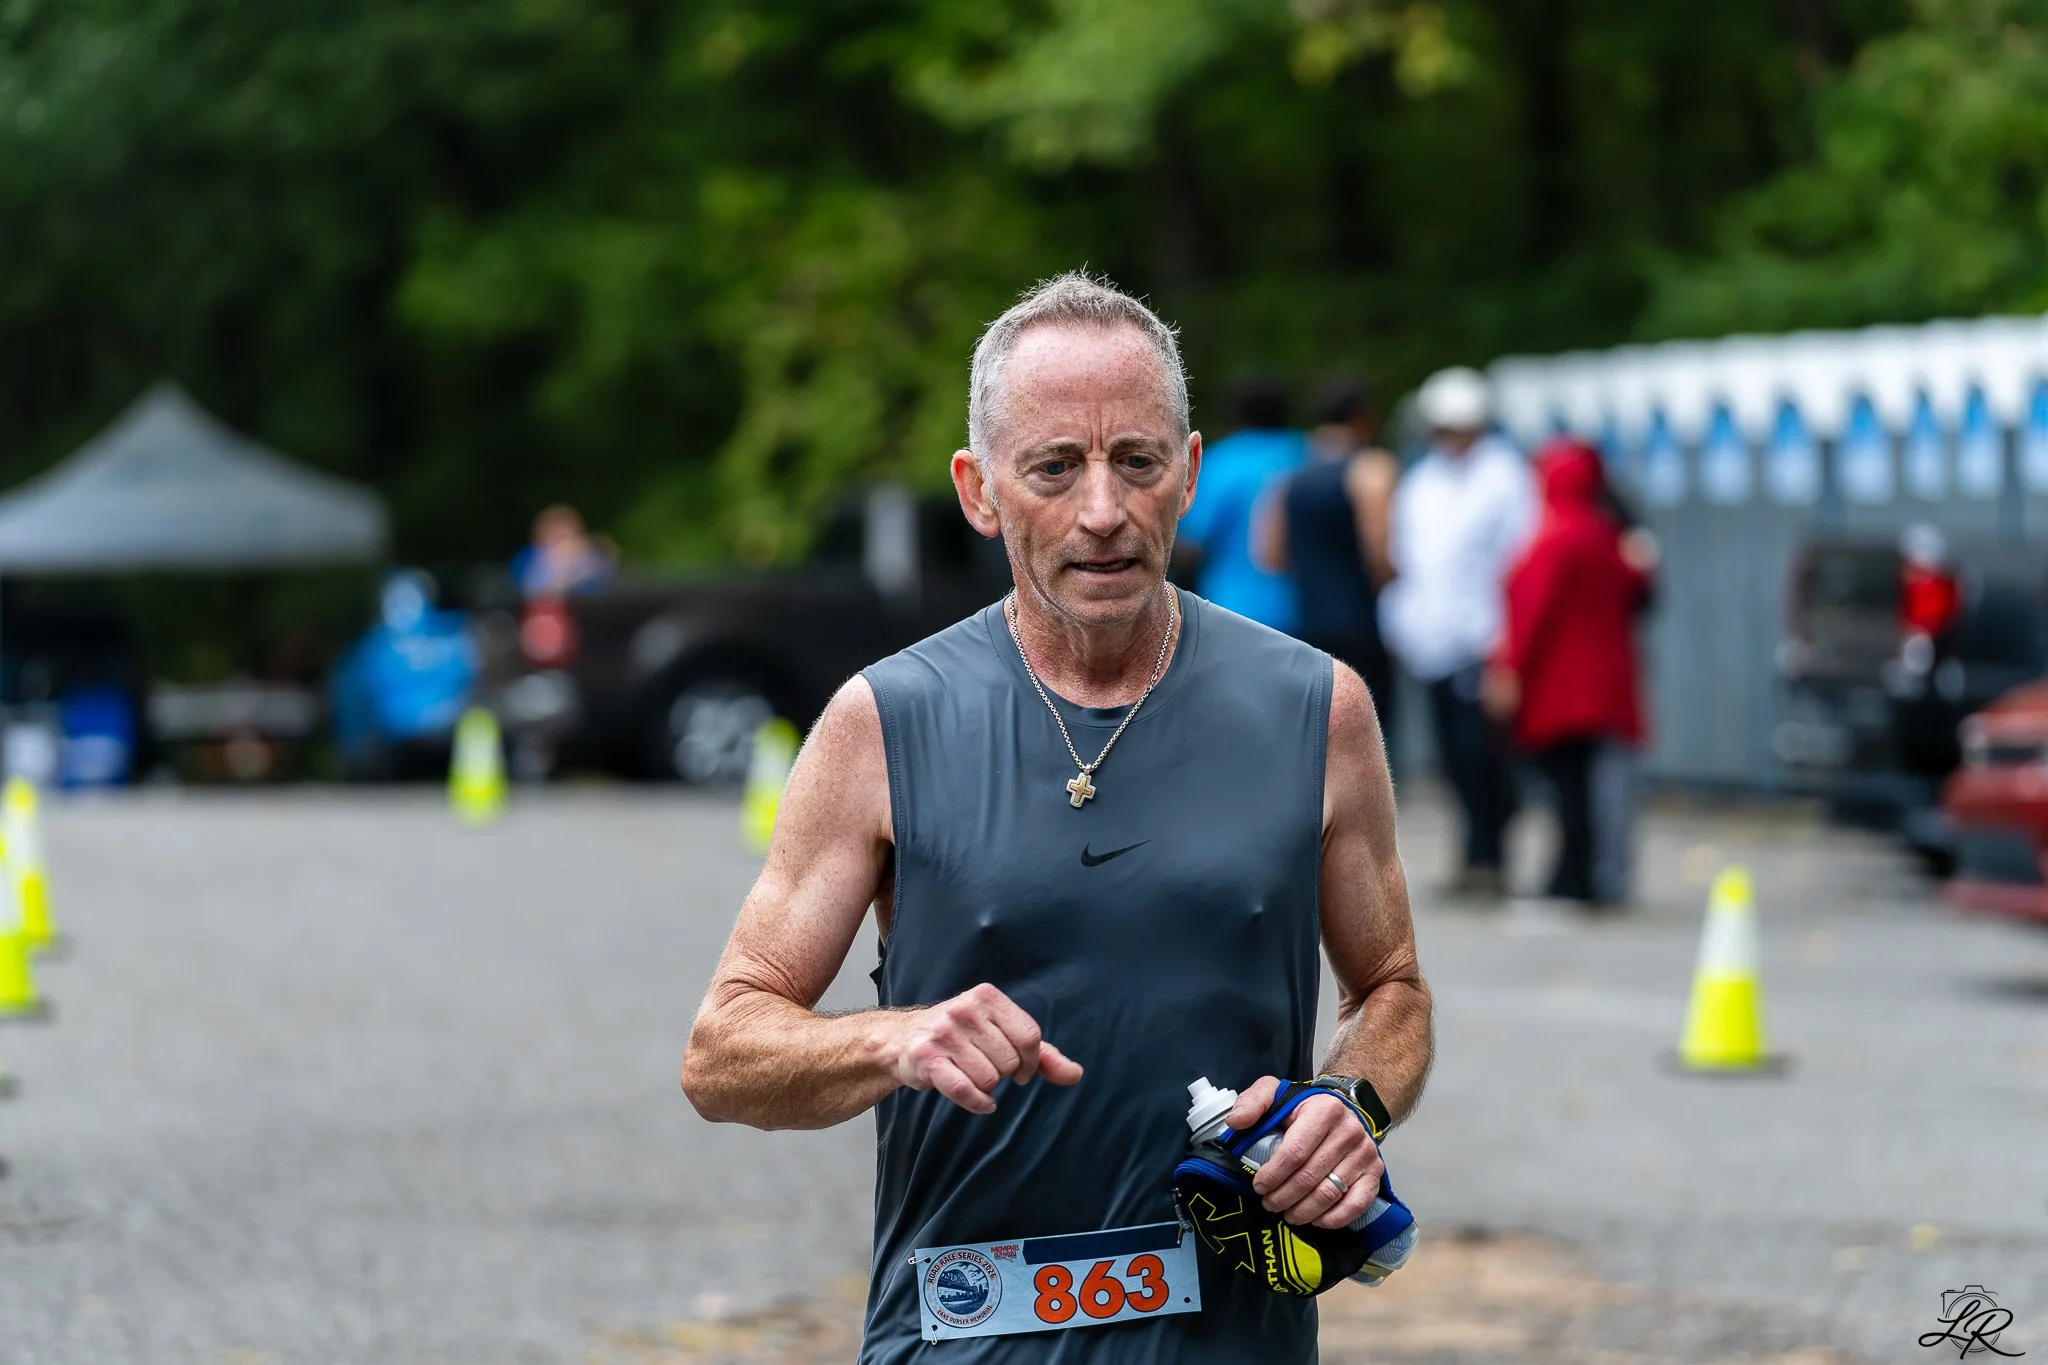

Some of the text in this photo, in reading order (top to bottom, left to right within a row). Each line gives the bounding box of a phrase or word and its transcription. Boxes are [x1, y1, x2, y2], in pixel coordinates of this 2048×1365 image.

[991, 1245, 1019, 1253] MEMPHIS
[927, 1252, 997, 1284] ROAD RACE SERIES 2026
[1033, 1253, 1169, 1324] 863
[970, 1305, 993, 1322] MEMORIAL
